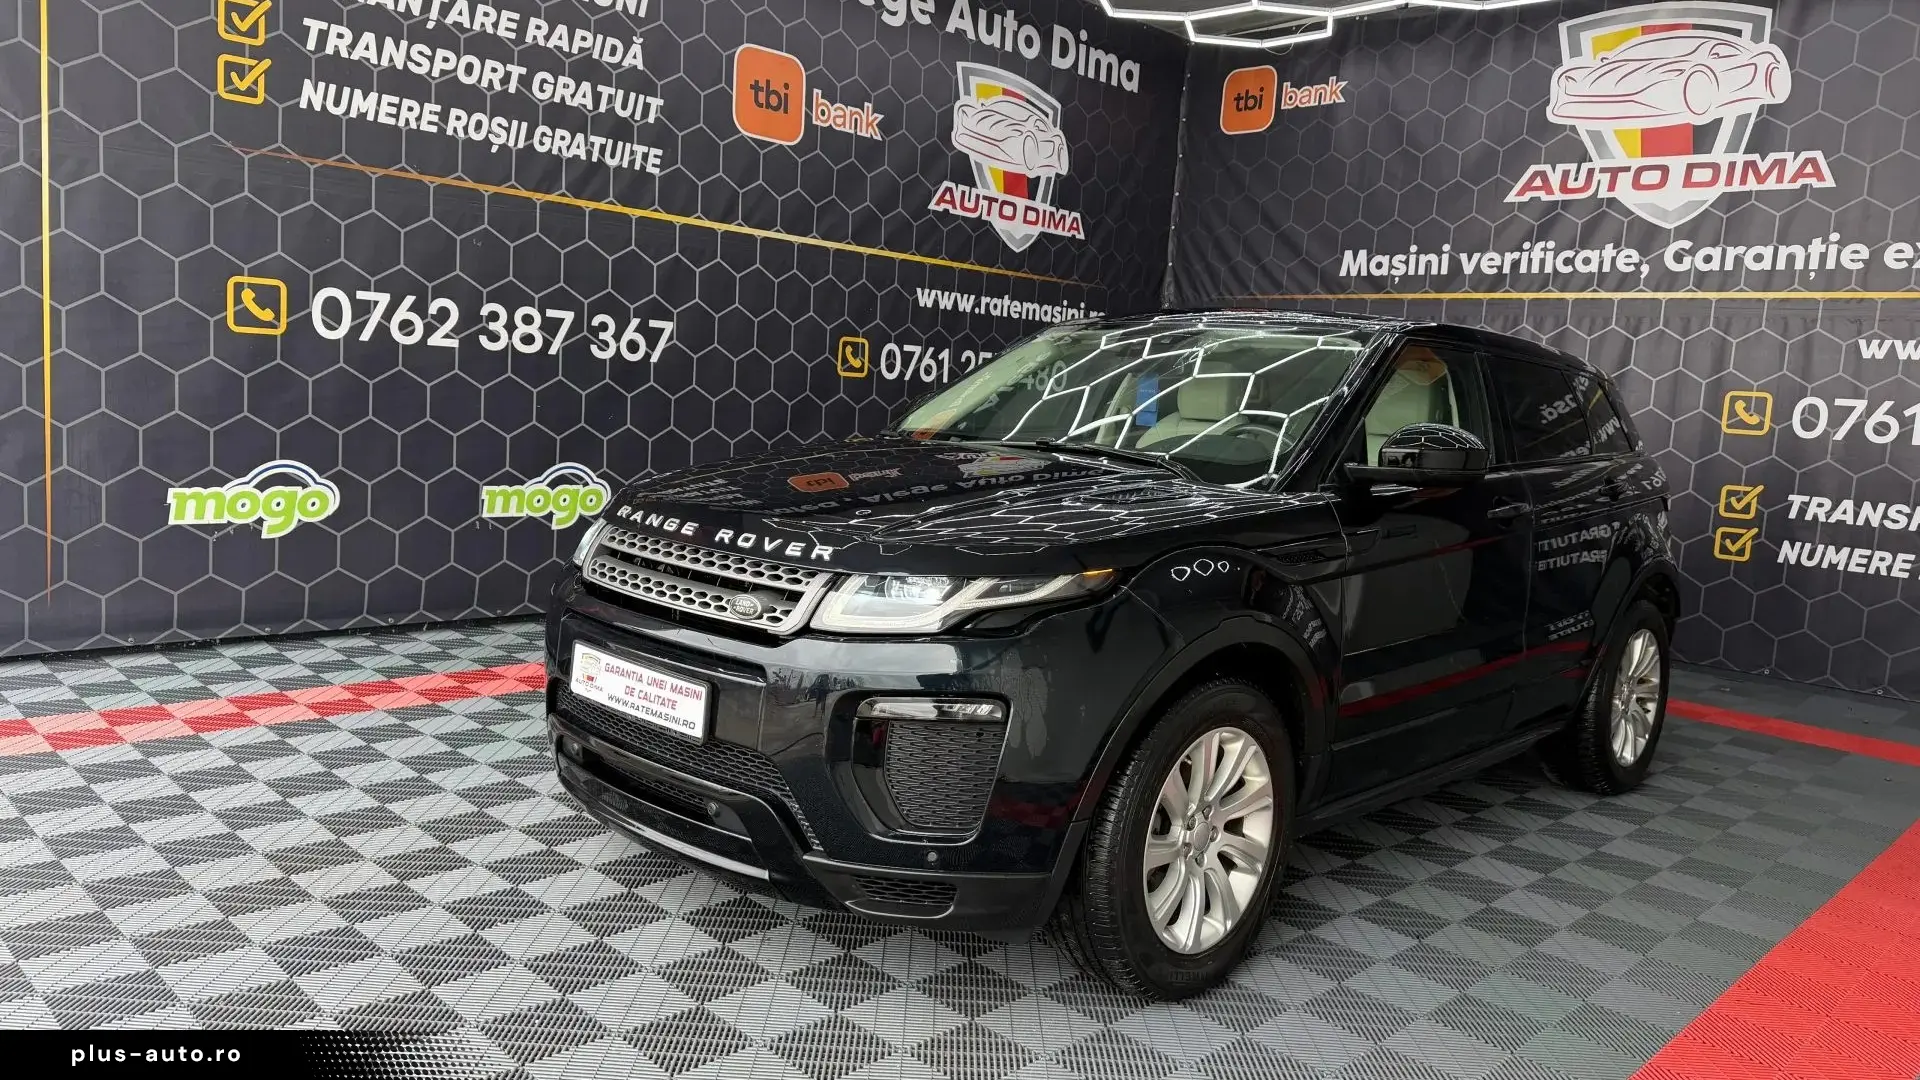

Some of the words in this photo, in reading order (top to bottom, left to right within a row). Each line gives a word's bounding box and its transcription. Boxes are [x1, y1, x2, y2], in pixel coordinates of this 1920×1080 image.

[525, 17, 644, 70] RAPIDĂ
[945, 0, 1041, 60] Auto
[1051, 24, 1140, 94] Dima
[302, 17, 527, 94] TRANSPORT
[532, 71, 664, 124] GRATUIT
[1234, 86, 1265, 112] tbi
[1282, 77, 1347, 108] bank
[299, 79, 442, 133] NUMERE
[446, 107, 528, 153] ROȘII
[533, 125, 663, 174] GRATUITE
[750, 79, 789, 114] tbi
[814, 89, 883, 139] bank
[1515, 163, 1670, 197] AUTO
[1682, 156, 1826, 189] DIMA
[935, 185, 1018, 222] AUTO
[1022, 204, 1081, 235] DIMA
[1339, 244, 1450, 285] Mașini
[1459, 240, 1650, 279] verificate,
[1663, 232, 1869, 280] Garanție
[311, 287, 460, 348] 0762
[478, 303, 575, 355] 387
[589, 313, 674, 363] 367
[880, 342, 950, 384] 0761
[1792, 396, 1920, 446] 0761
[171, 486, 331, 537] mogo
[485, 485, 606, 527] mogo
[616, 505, 699, 536] RANGE
[715, 528, 835, 561] ROVER
[1777, 540, 1916, 578] NUMERE
[604, 662, 643, 683] GARANTIA
[646, 675, 667, 690] UNEI
[669, 684, 703, 701] MASINI
[624, 685, 636, 697] DE
[638, 689, 678, 710] CALITATE
[607, 692, 696, 730] WWW.RATEMASINI.RO
